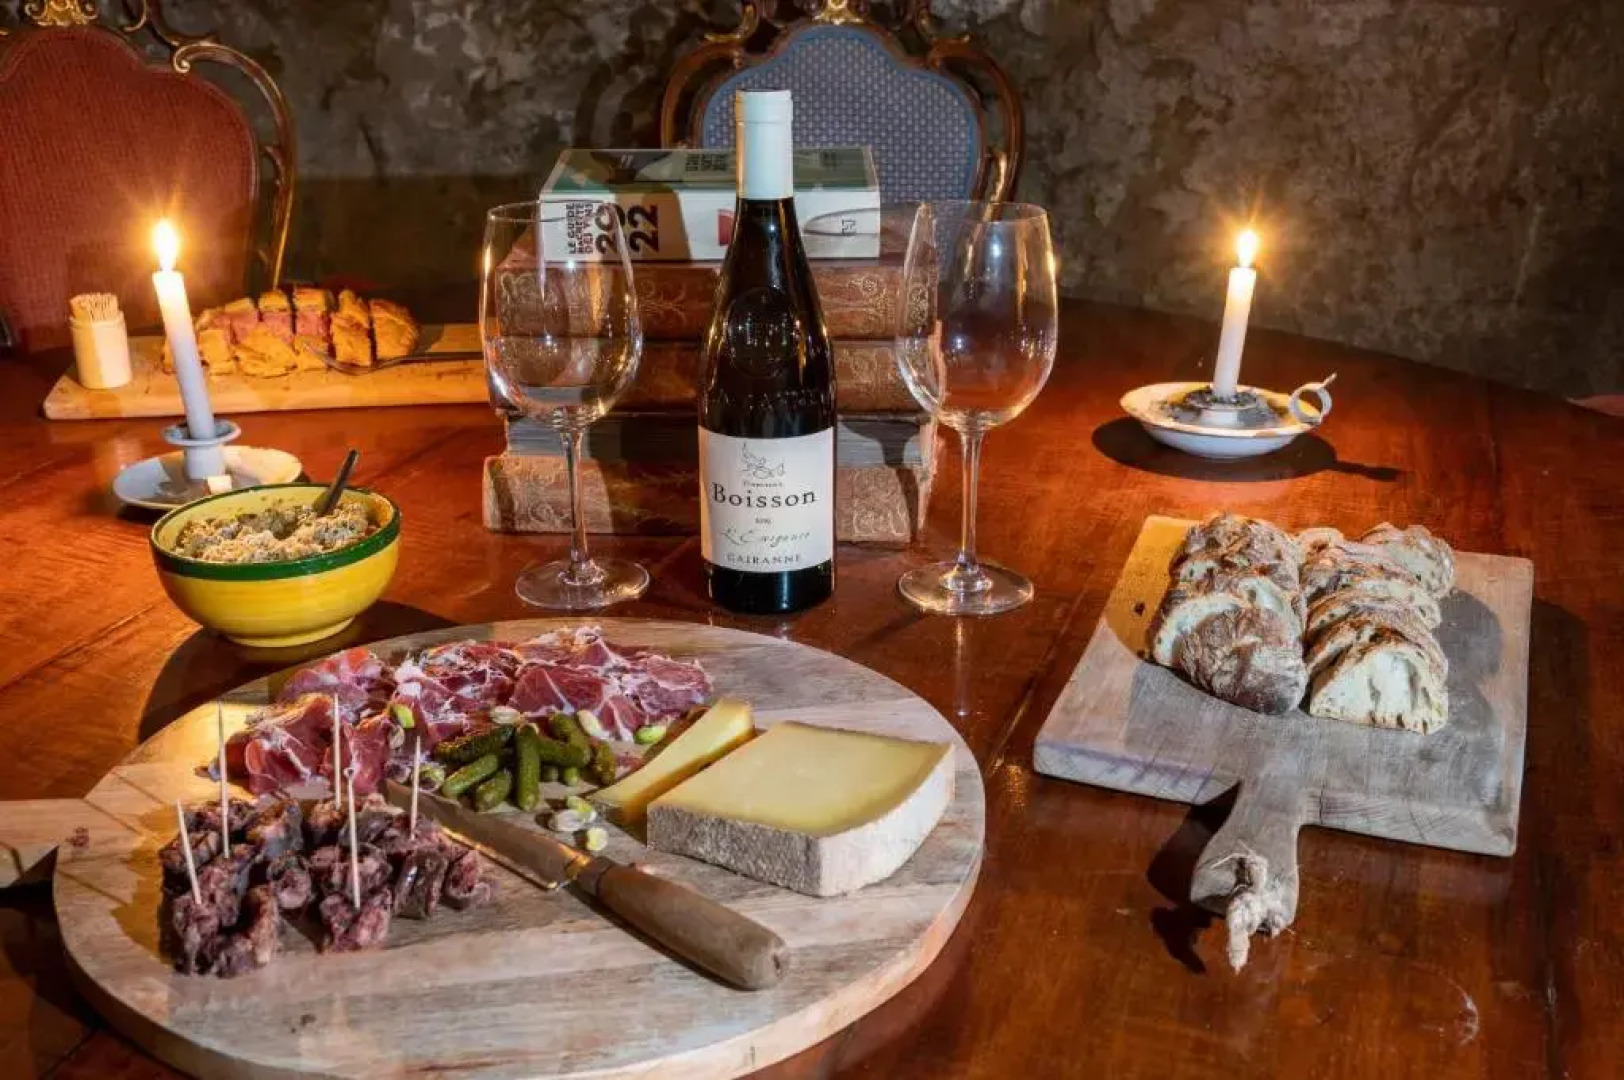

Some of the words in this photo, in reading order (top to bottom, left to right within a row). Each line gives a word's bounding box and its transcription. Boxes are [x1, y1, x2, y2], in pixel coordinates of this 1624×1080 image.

[566, 203, 575, 238] GUIDE
[576, 203, 585, 254] HACHETTE
[595, 203, 626, 254] 20
[628, 204, 659, 253] 22
[568, 242, 576, 254] LE
[712, 481, 816, 508] Boisson
